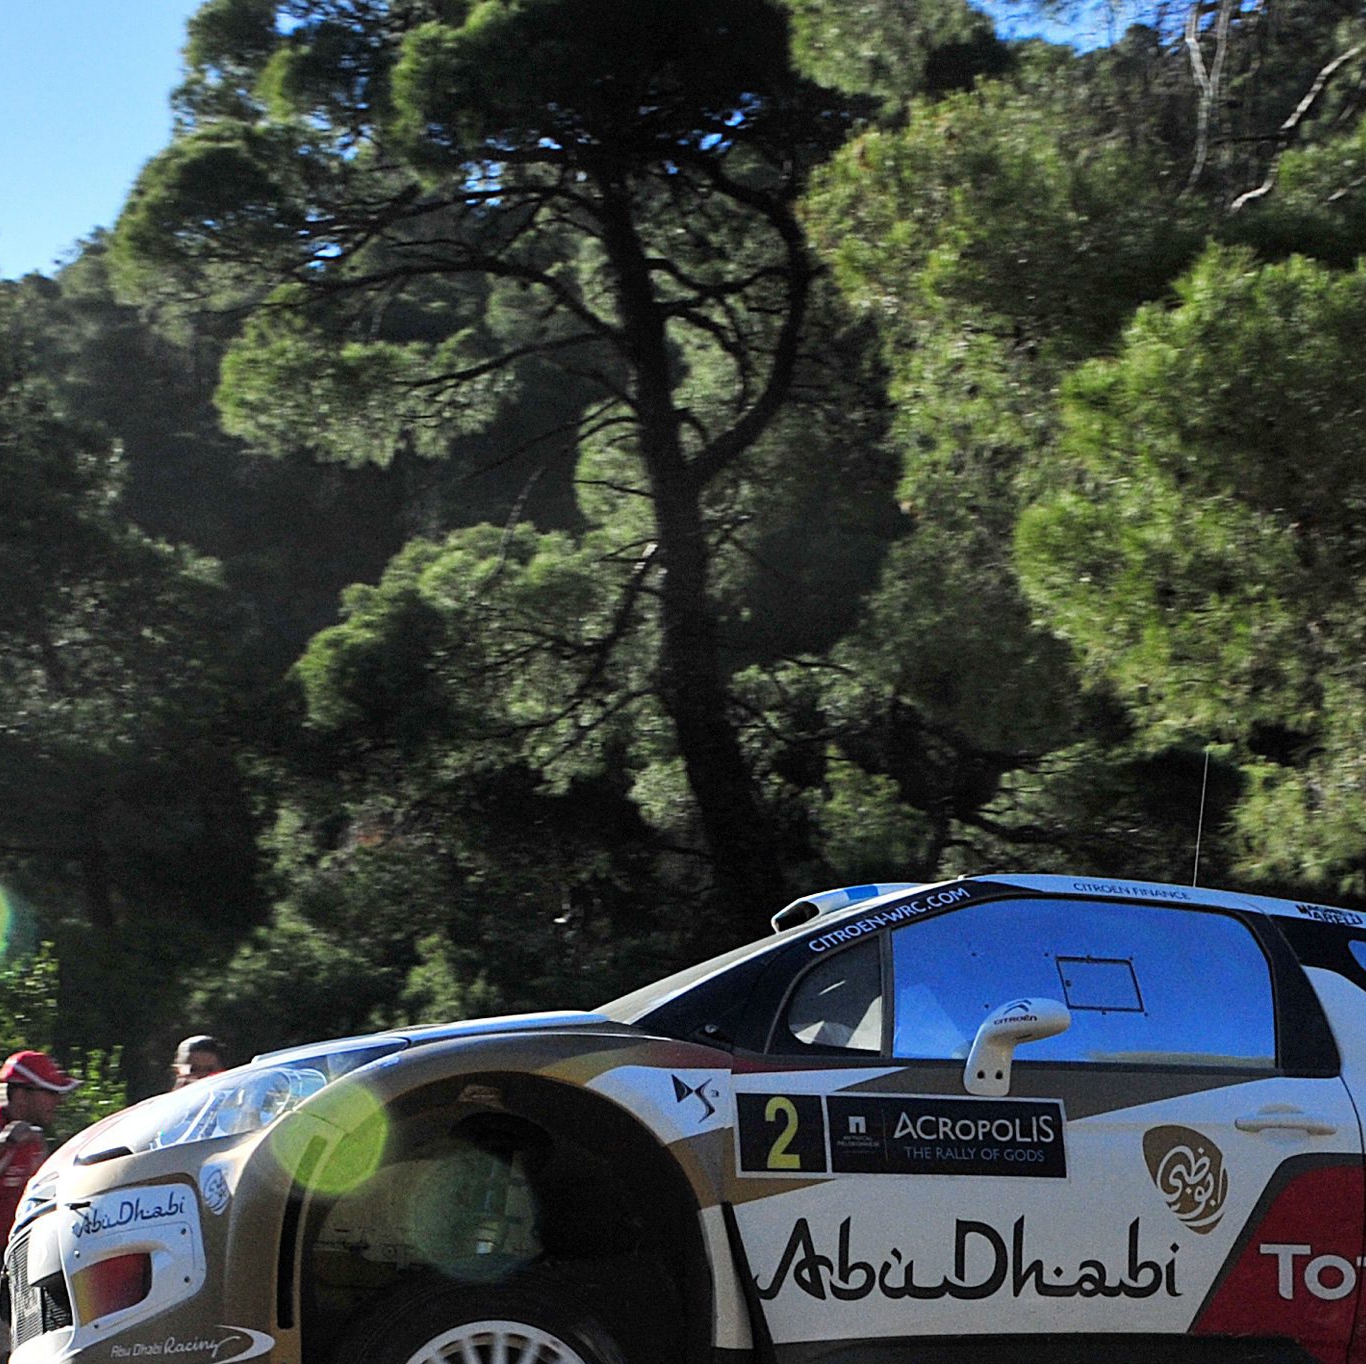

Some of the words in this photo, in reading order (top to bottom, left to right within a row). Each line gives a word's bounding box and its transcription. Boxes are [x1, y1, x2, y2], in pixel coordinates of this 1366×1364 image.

[808, 886, 971, 954] CITROEN-WRC.COM
[764, 1096, 802, 1169] 2
[893, 1111, 1055, 1143] ACROPOLIS
[904, 1146, 932, 1160] THE
[935, 1147, 976, 1161] RALLY
[980, 1148, 1001, 1161] OF
[1003, 1149, 1045, 1162] GODS
[163, 1336, 240, 1358] Racing
